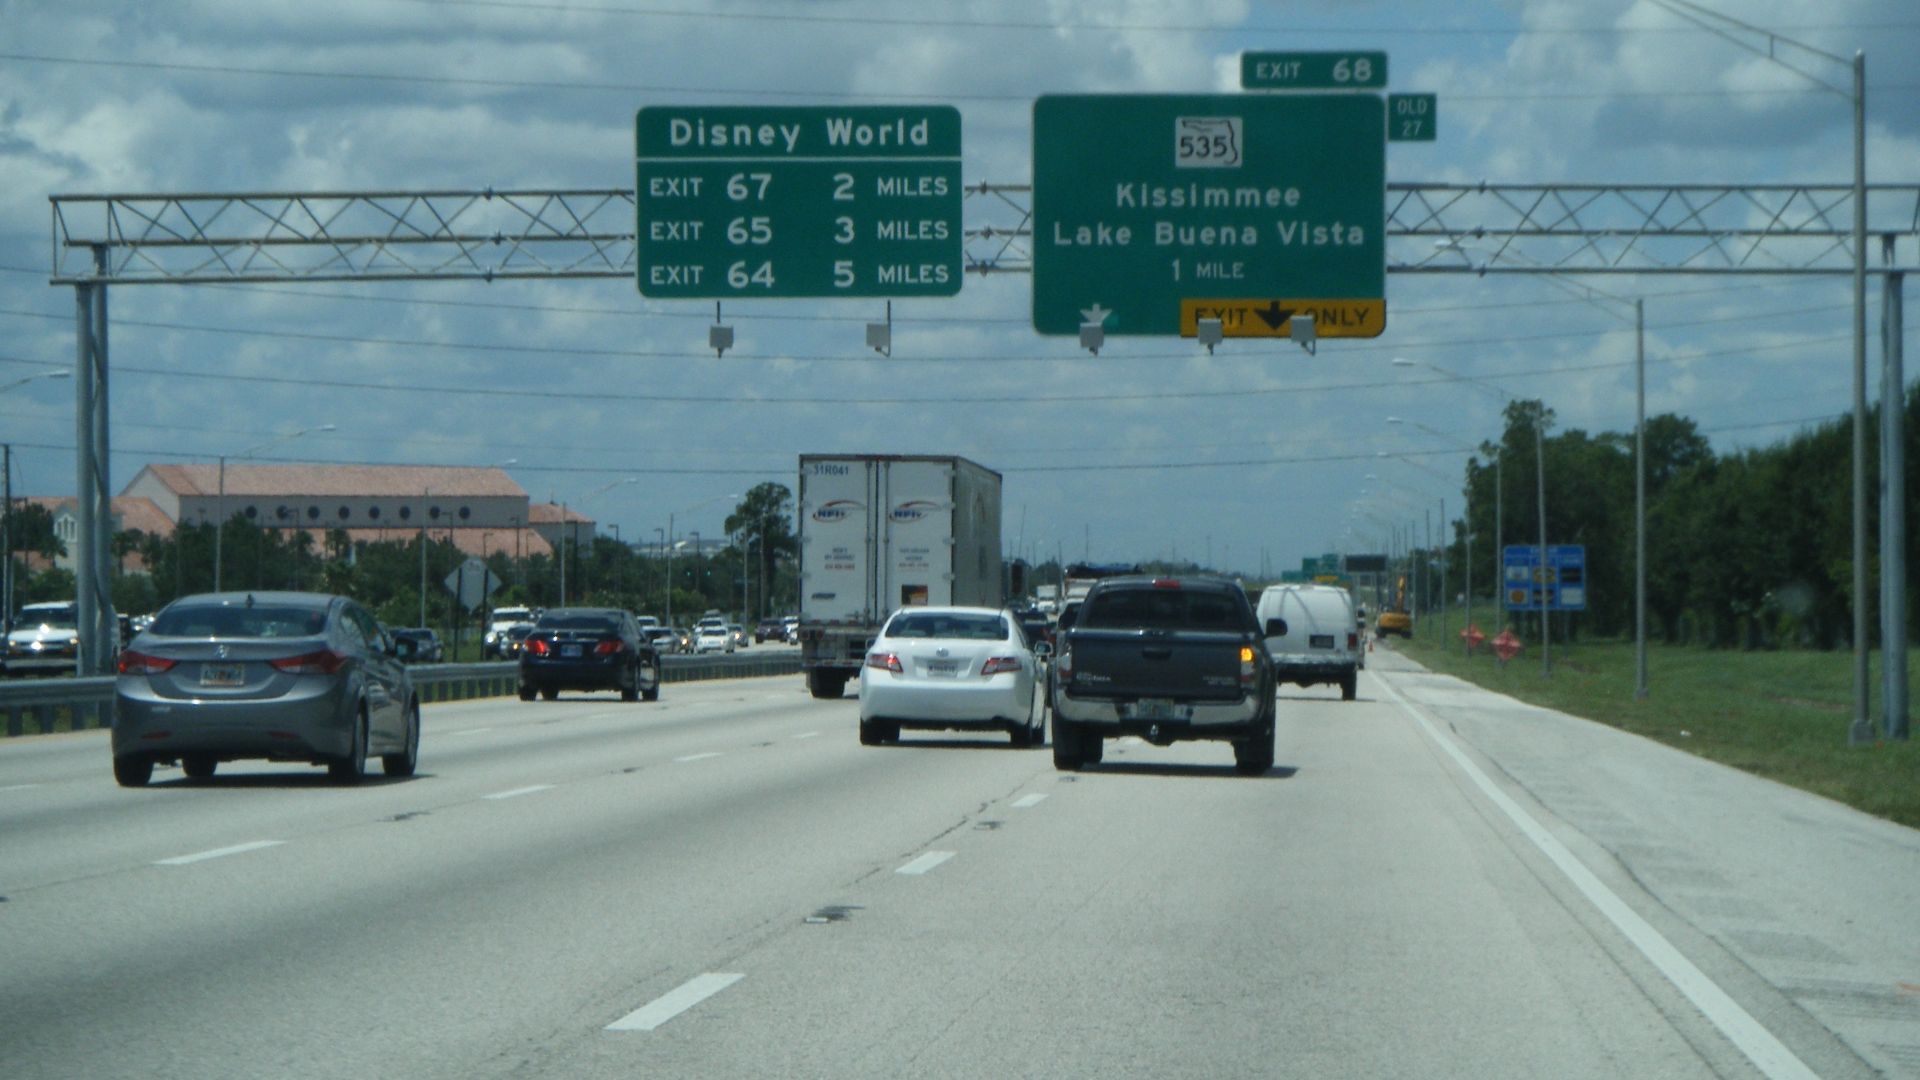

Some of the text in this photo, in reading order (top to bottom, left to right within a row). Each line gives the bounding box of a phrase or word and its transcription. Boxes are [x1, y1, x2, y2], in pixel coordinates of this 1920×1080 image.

[1256, 59, 1372, 82] EXIT 68
[1397, 99, 1427, 114] OLD
[670, 118, 929, 153] Disney World
[1402, 121, 1422, 137] 27
[1179, 136, 1228, 159] 535
[650, 173, 949, 201] EXIT 67 2 MILES
[1117, 184, 1301, 208] Kissimmee
[650, 217, 949, 244] EXIT 65 3 MILES
[1054, 222, 1364, 246] Lake Buena Vista
[650, 261, 949, 289] EXIT 64 5 MILES
[1171, 259, 1245, 281] 1 MILE
